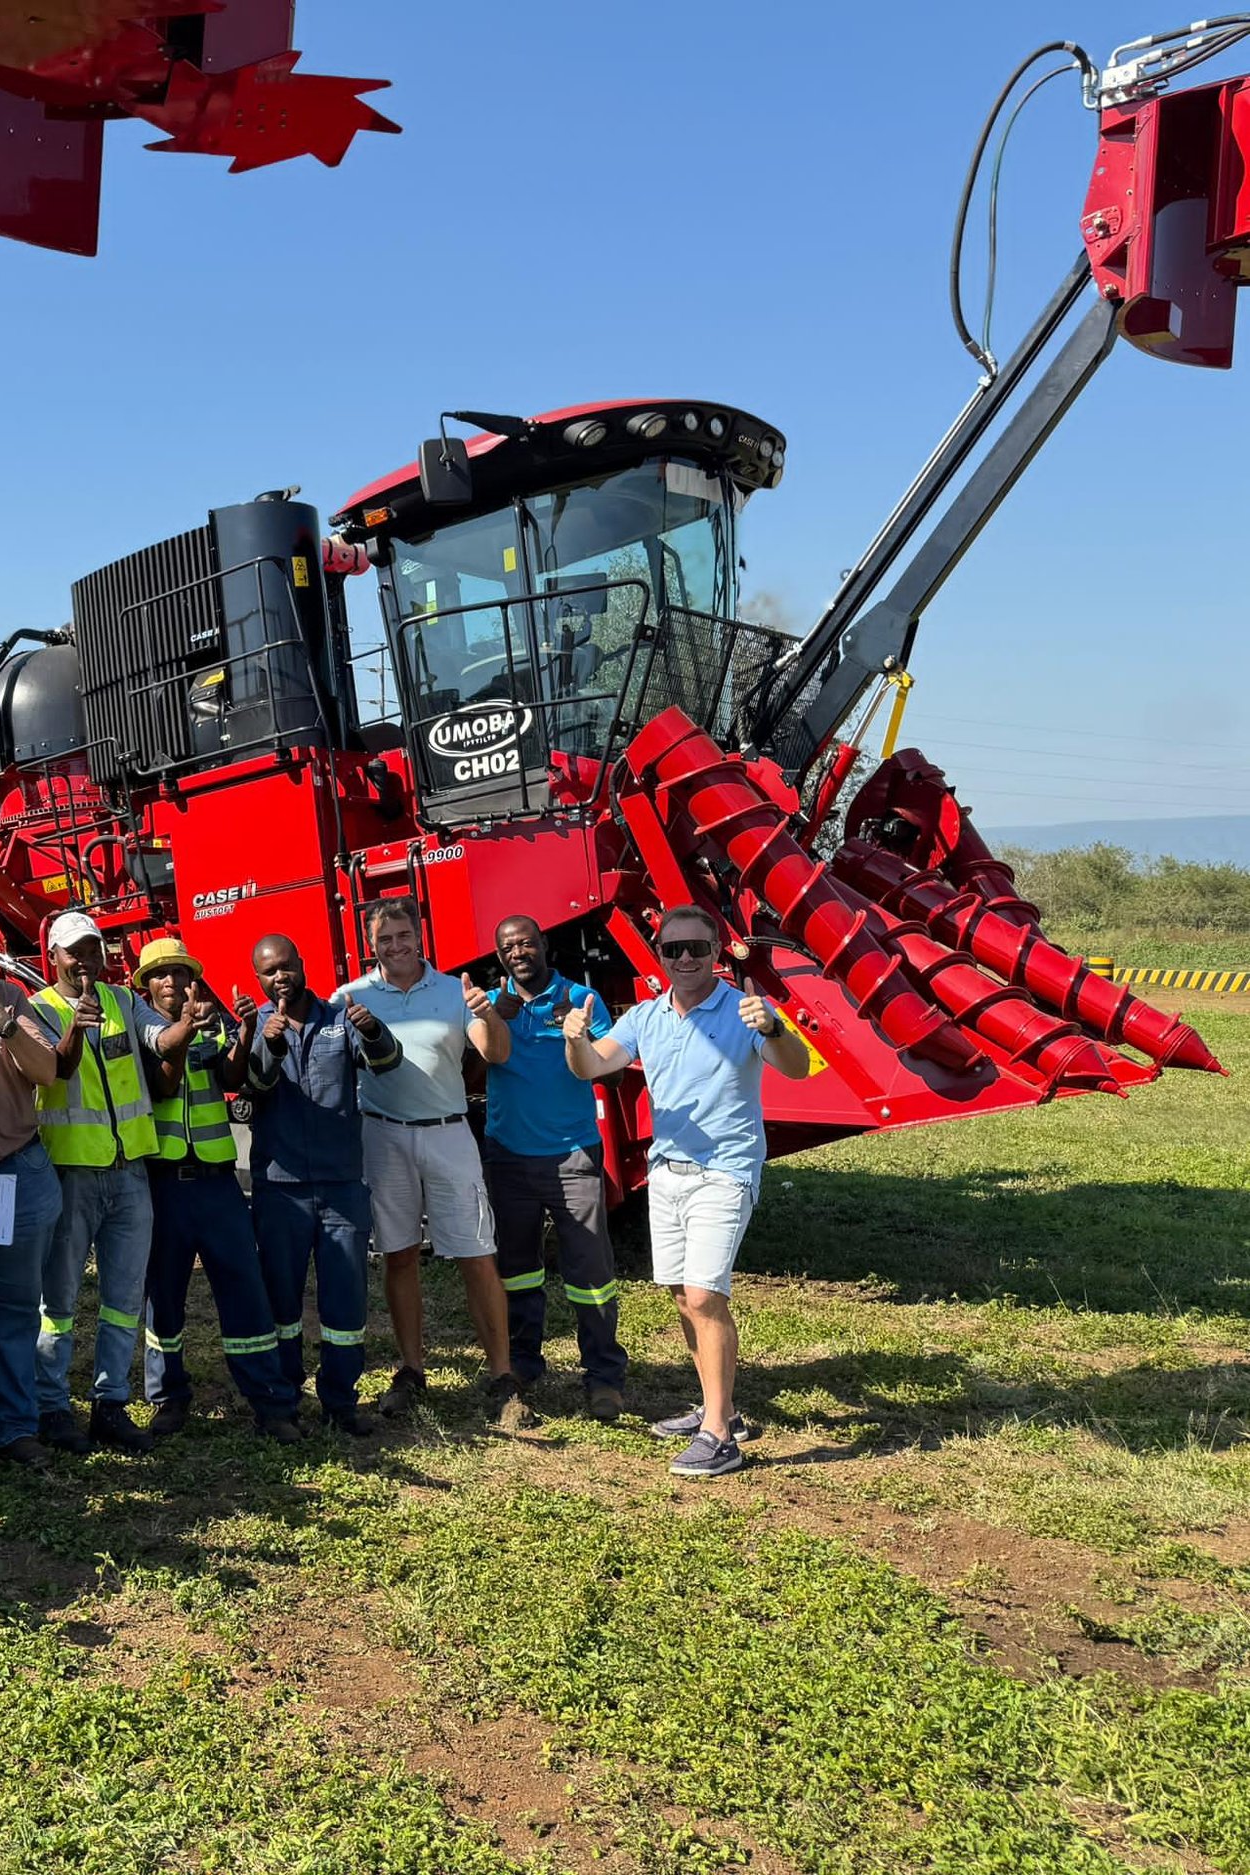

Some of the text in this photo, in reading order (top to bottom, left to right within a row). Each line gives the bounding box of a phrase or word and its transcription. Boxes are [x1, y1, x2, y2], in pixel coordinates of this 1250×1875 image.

[437, 711, 515, 745] UMOBA
[454, 749, 520, 781] CH02
[427, 845, 463, 864] 9900
[193, 887, 239, 907] CASE
